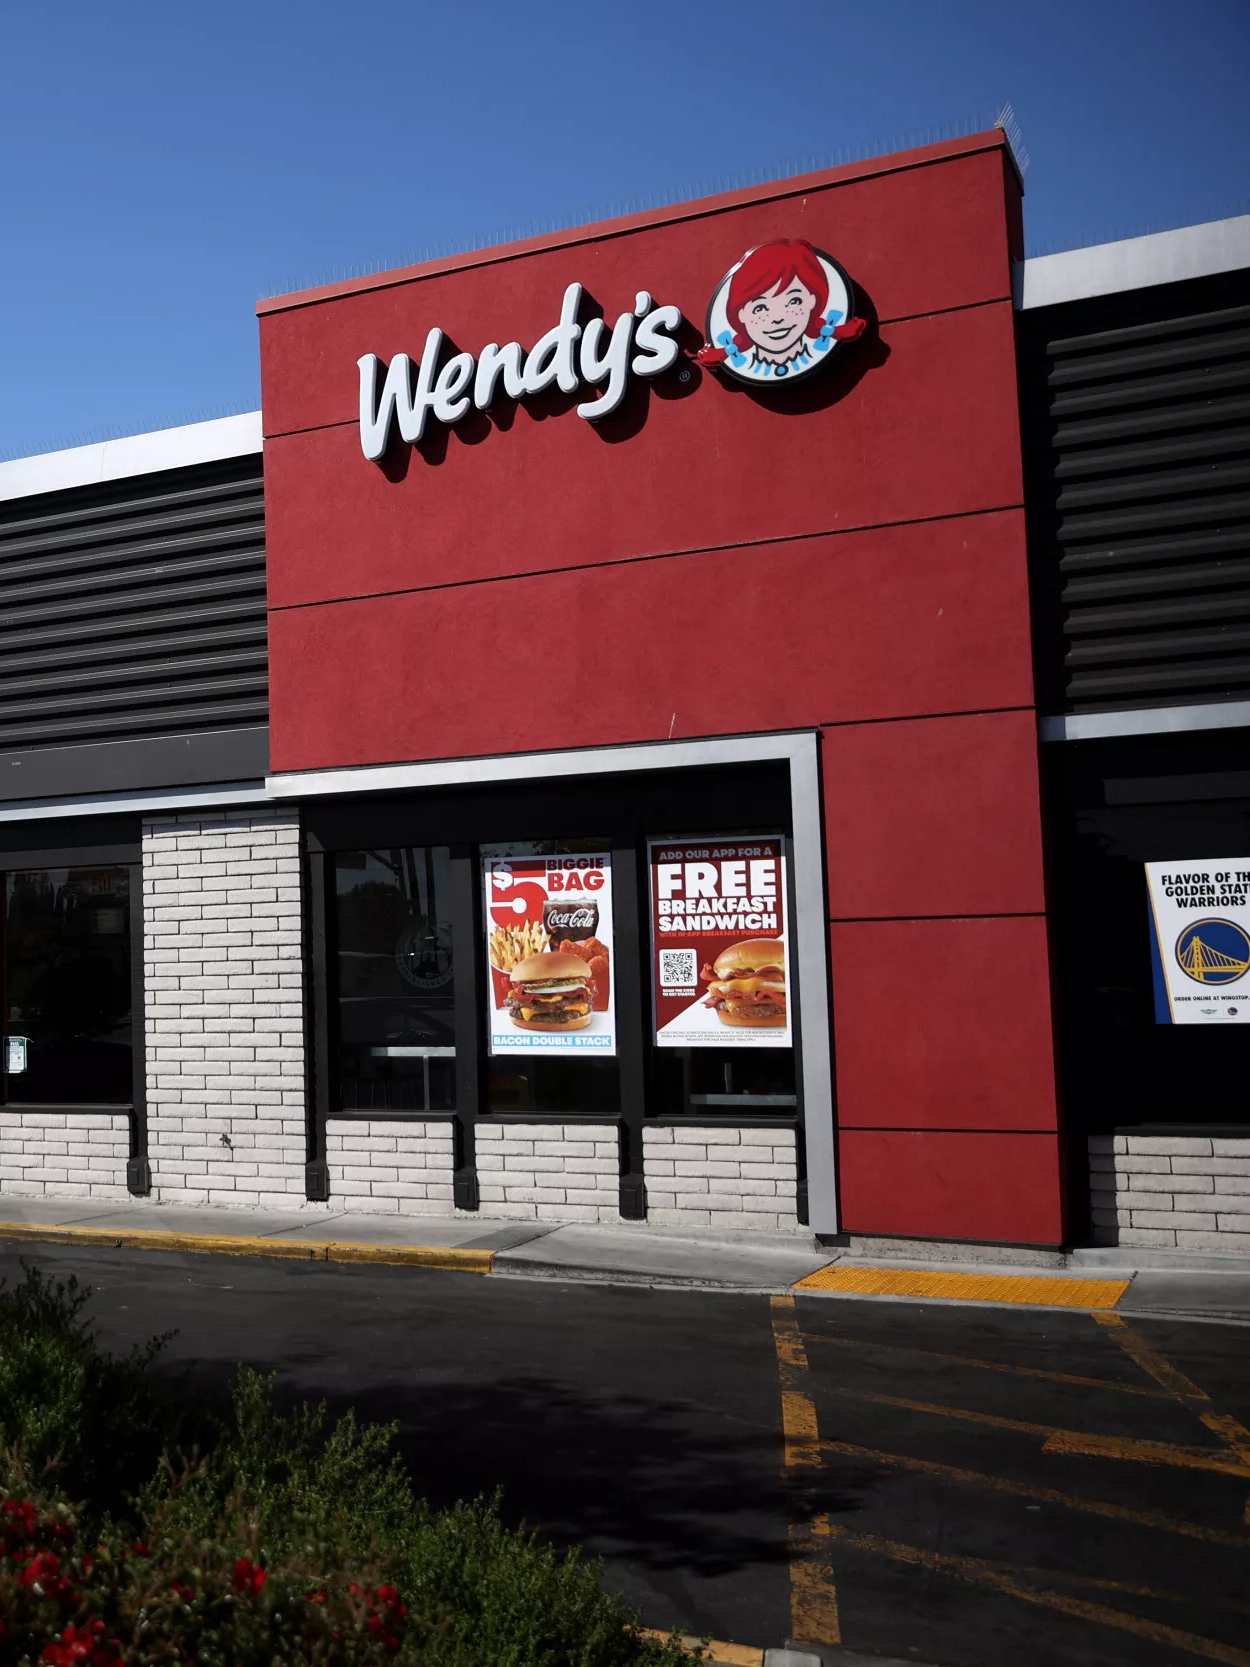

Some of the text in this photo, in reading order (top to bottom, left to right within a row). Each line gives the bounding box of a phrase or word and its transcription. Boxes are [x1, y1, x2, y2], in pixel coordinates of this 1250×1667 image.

[357, 282, 681, 461] Wendy's
[659, 846, 773, 861] ADD OUR APP FOR A
[548, 871, 604, 891] BAG
[657, 860, 776, 899] FREE
[1161, 872, 1210, 886] FLAVOR
[1214, 871, 1231, 883] OF
[1165, 884, 1215, 897] GOLDEN
[658, 896, 777, 915] BREAKFAST
[1175, 895, 1246, 908] WARRIORS
[547, 908, 595, 928] Coca-Cola
[658, 913, 777, 932] SANDWICH
[493, 1036, 610, 1045] BACON DOUBLE STACK
